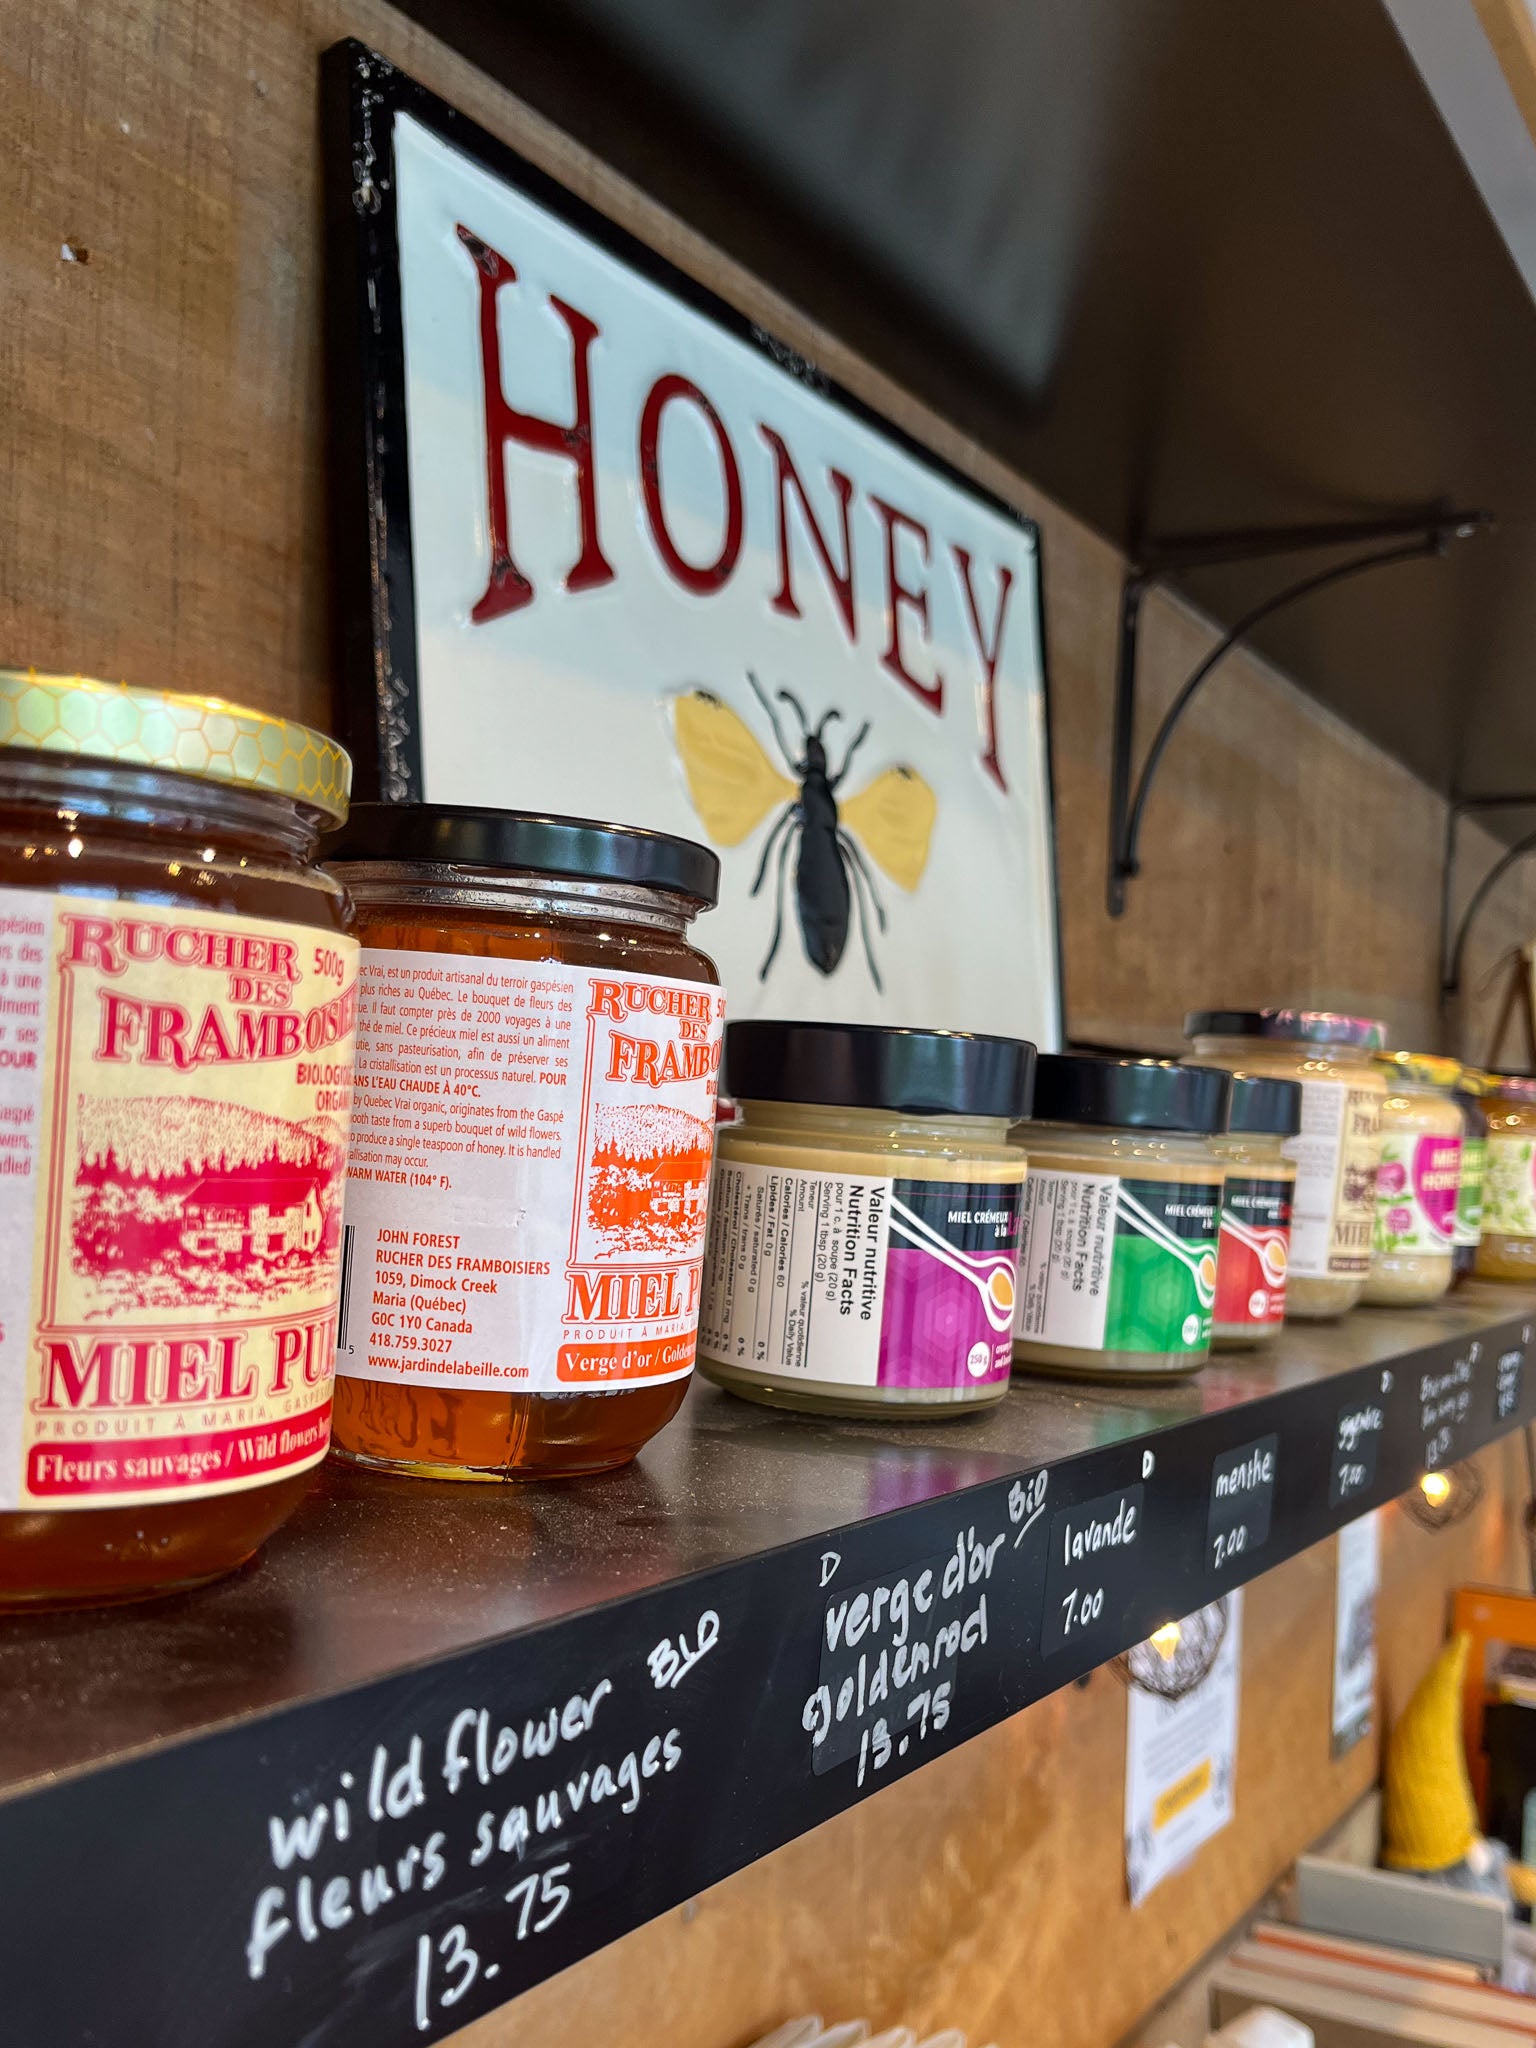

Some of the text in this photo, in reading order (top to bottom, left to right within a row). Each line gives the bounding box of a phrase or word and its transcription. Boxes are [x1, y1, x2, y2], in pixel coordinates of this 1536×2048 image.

[457, 224, 1013, 795] HONEY
[58, 913, 303, 983] RUCHER
[313, 947, 345, 986] 500g
[369, 965, 574, 994] Vrai, un produit artisanal du terroir gaspésien
[226, 974, 294, 1008] DES
[379, 983, 572, 1013] riches au Québec. Le bouquet de fleurs des
[586, 978, 712, 1024] RUCHER
[380, 1002, 571, 1031] faut compter près de 2000 voyages une
[679, 1019, 709, 1041] DES
[373, 1021, 570, 1049] de miel. Ce précieux miel est aussi un aliment
[376, 1042, 568, 1068] sans pasteurisation, afin de préserver ses
[369, 1058, 567, 1086] cristallisation est un processus naturel. POUR
[372, 1076, 481, 1098] L'EAU CHAUDE 40°C.
[364, 1094, 564, 1125] Quebec Vrai organic, originates from the Gaspé
[371, 1114, 562, 1141] taste from superb bouquet of wild flowers.
[356, 1132, 561, 1159] produce single teaspoon of honey. handled
[375, 1168, 437, 1187] WATER (104°
[385, 1156, 429, 1168] may occur.
[768, 1175, 778, 1213] Lipides
[797, 1179, 808, 1212] Amount
[807, 1181, 817, 1209] Teneur
[1164, 1203, 1185, 1217] MIEL
[778, 1177, 793, 1271] Calories Calories
[817, 1182, 833, 1251] Serving tbsp
[829, 1182, 844, 1270] pour soupe
[947, 1210, 972, 1224] MIEL
[973, 1208, 1009, 1224] CRÉMEUX
[377, 1228, 460, 1249] JOHN FOREST
[840, 1185, 864, 1315] Nutrition Facts
[860, 1186, 885, 1320] Valeur nutritive
[1072, 1183, 1095, 1292] Nutrition Facts
[1089, 1184, 1113, 1297] Valeur nutritive
[376, 1249, 551, 1275] RUCHER DES FRAMBOISIERS
[375, 1270, 498, 1294] 1059, Dimock Creek
[561, 1270, 683, 1325] MIEL
[373, 1290, 467, 1315] Maria (Québec)
[400, 1314, 421, 1330] 1Y0
[426, 1317, 473, 1334] Canada
[563, 1327, 633, 1340] PRODUIT
[369, 1332, 452, 1353] 418.759.3027
[785, 1319, 796, 1366] Daily Value
[795, 1318, 805, 1368] quotidienne
[30, 1330, 260, 1415] MIEL
[368, 1354, 529, 1378] www.jardindelabeille.com
[565, 1352, 618, 1376] Verge
[35, 1417, 156, 1437] PRODUIT
[36, 1432, 277, 1483] Fleurs sauvages Wild
[1215, 1448, 1273, 1498] menthe
[1063, 1498, 1137, 1567] lavande
[1213, 1524, 1248, 1569] 7.00
[826, 1568, 934, 1653] verge
[1061, 1587, 1105, 1636] 7.00
[802, 1593, 989, 1748] goldenrod
[246, 1727, 682, 1980] fleurs sauvages
